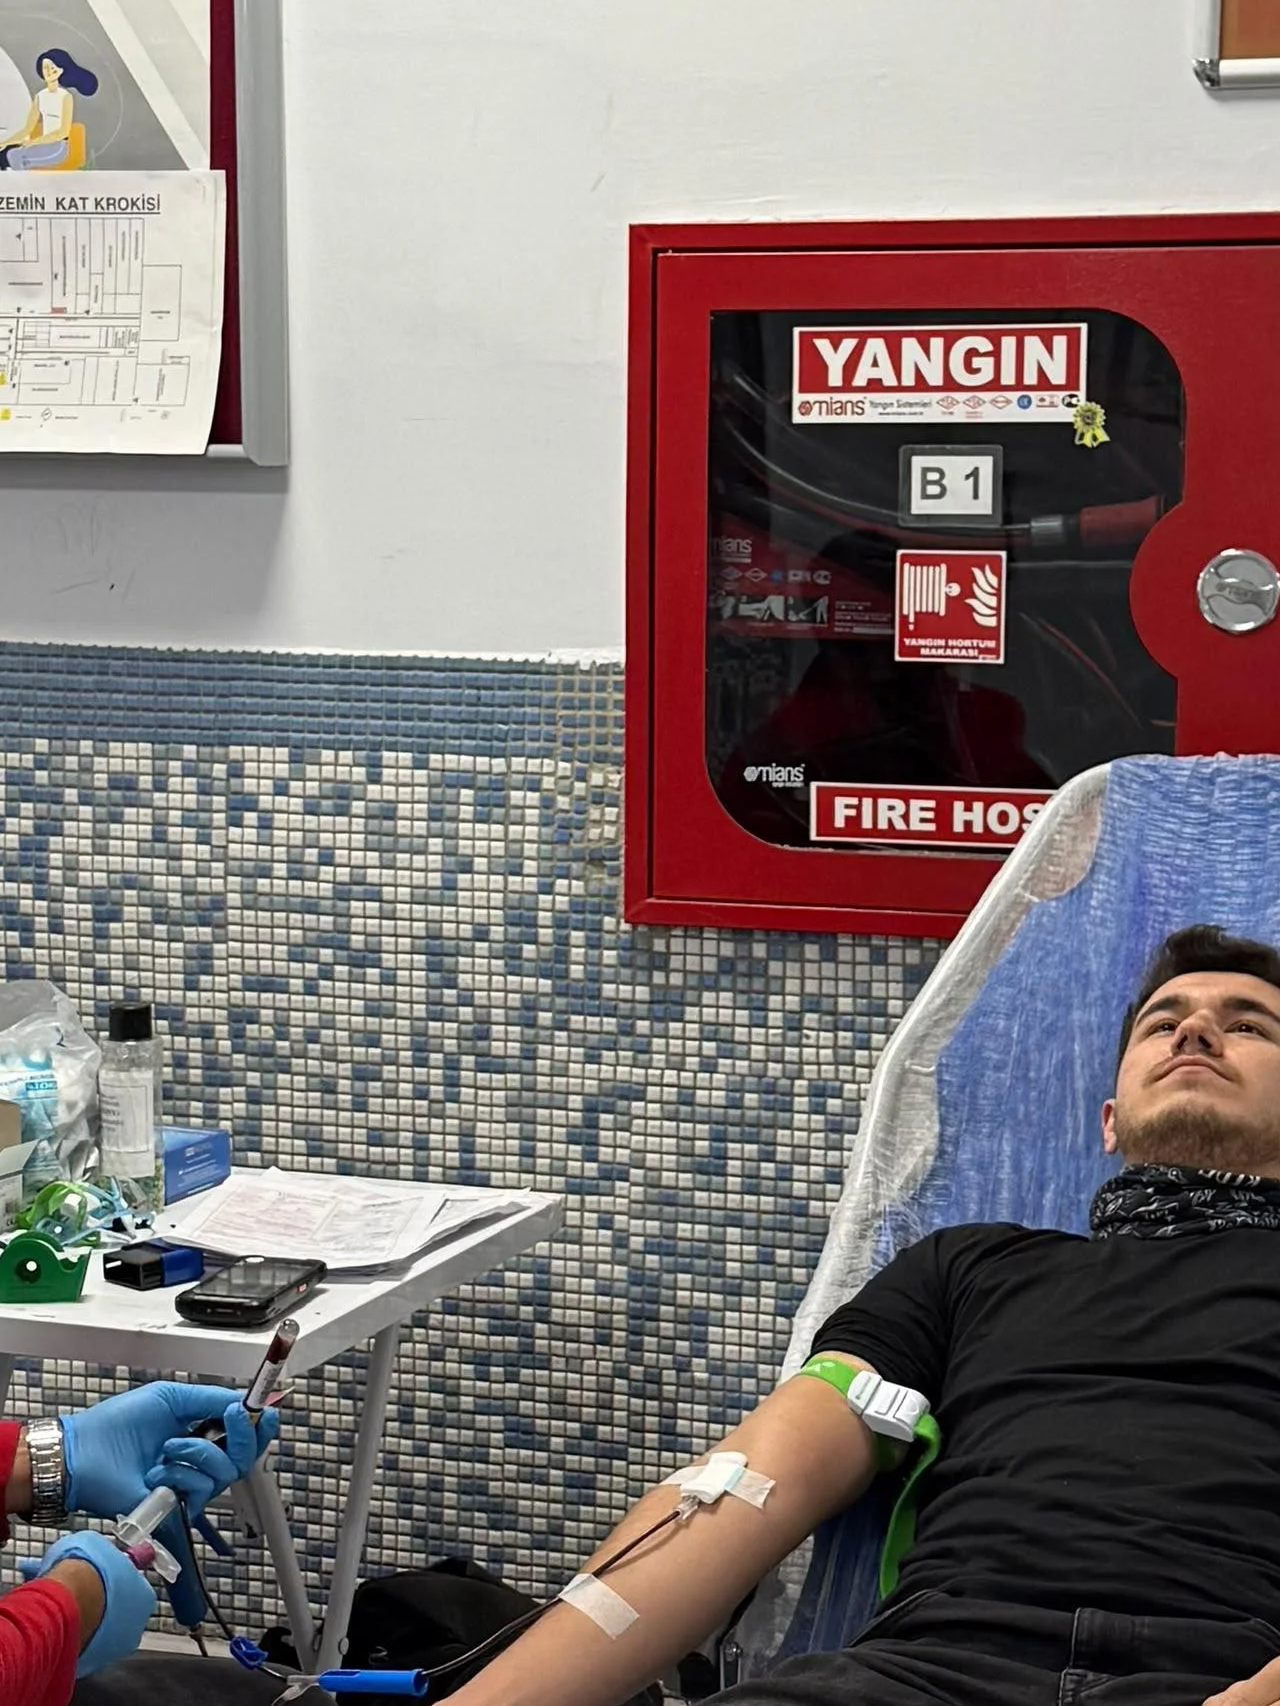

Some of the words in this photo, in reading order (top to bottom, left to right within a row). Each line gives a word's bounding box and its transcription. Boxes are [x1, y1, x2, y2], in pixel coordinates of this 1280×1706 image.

[56, 196, 90, 211] KAT
[94, 193, 161, 211] KROKİSİ
[813, 336, 1067, 388] YANGIN
[921, 466, 948, 501] B
[964, 466, 982, 501] 1
[904, 638, 946, 646] YANGIN
[948, 638, 996, 648] HORTUM
[920, 647, 978, 657] MAKARASI
[834, 796, 937, 831] FIRE
[952, 800, 1046, 835] HOS
